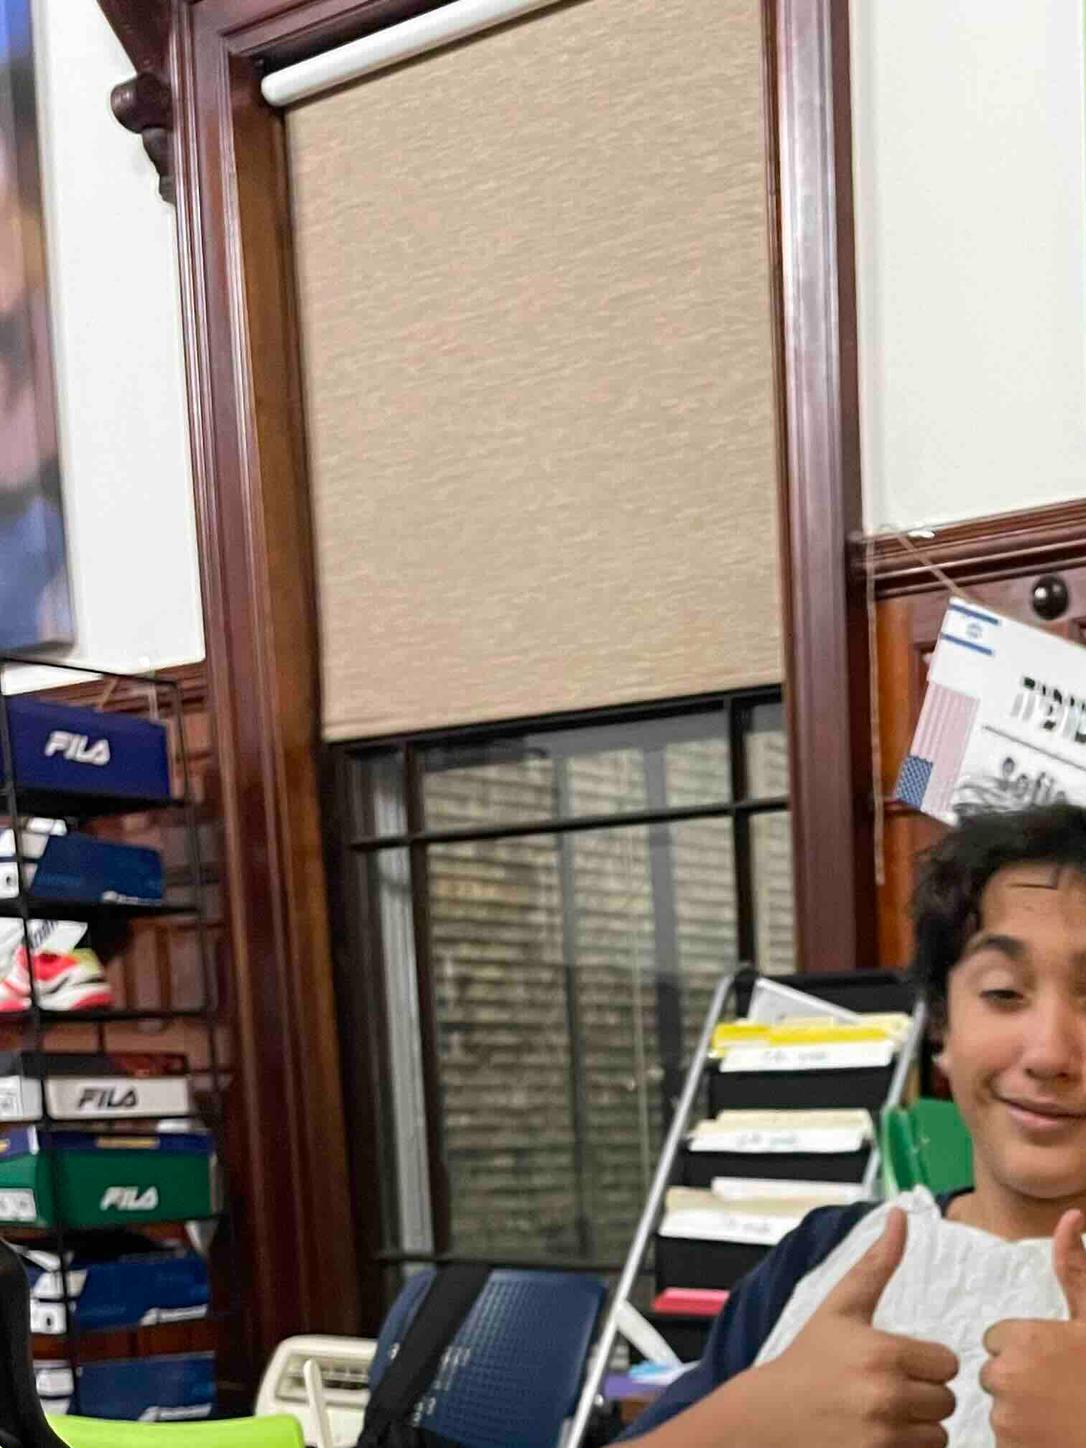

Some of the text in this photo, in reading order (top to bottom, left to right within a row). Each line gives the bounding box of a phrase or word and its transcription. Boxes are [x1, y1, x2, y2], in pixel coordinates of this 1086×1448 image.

[44, 730, 111, 767] FILA
[77, 1088, 137, 1110] FILA
[99, 1186, 159, 1211] FILA
